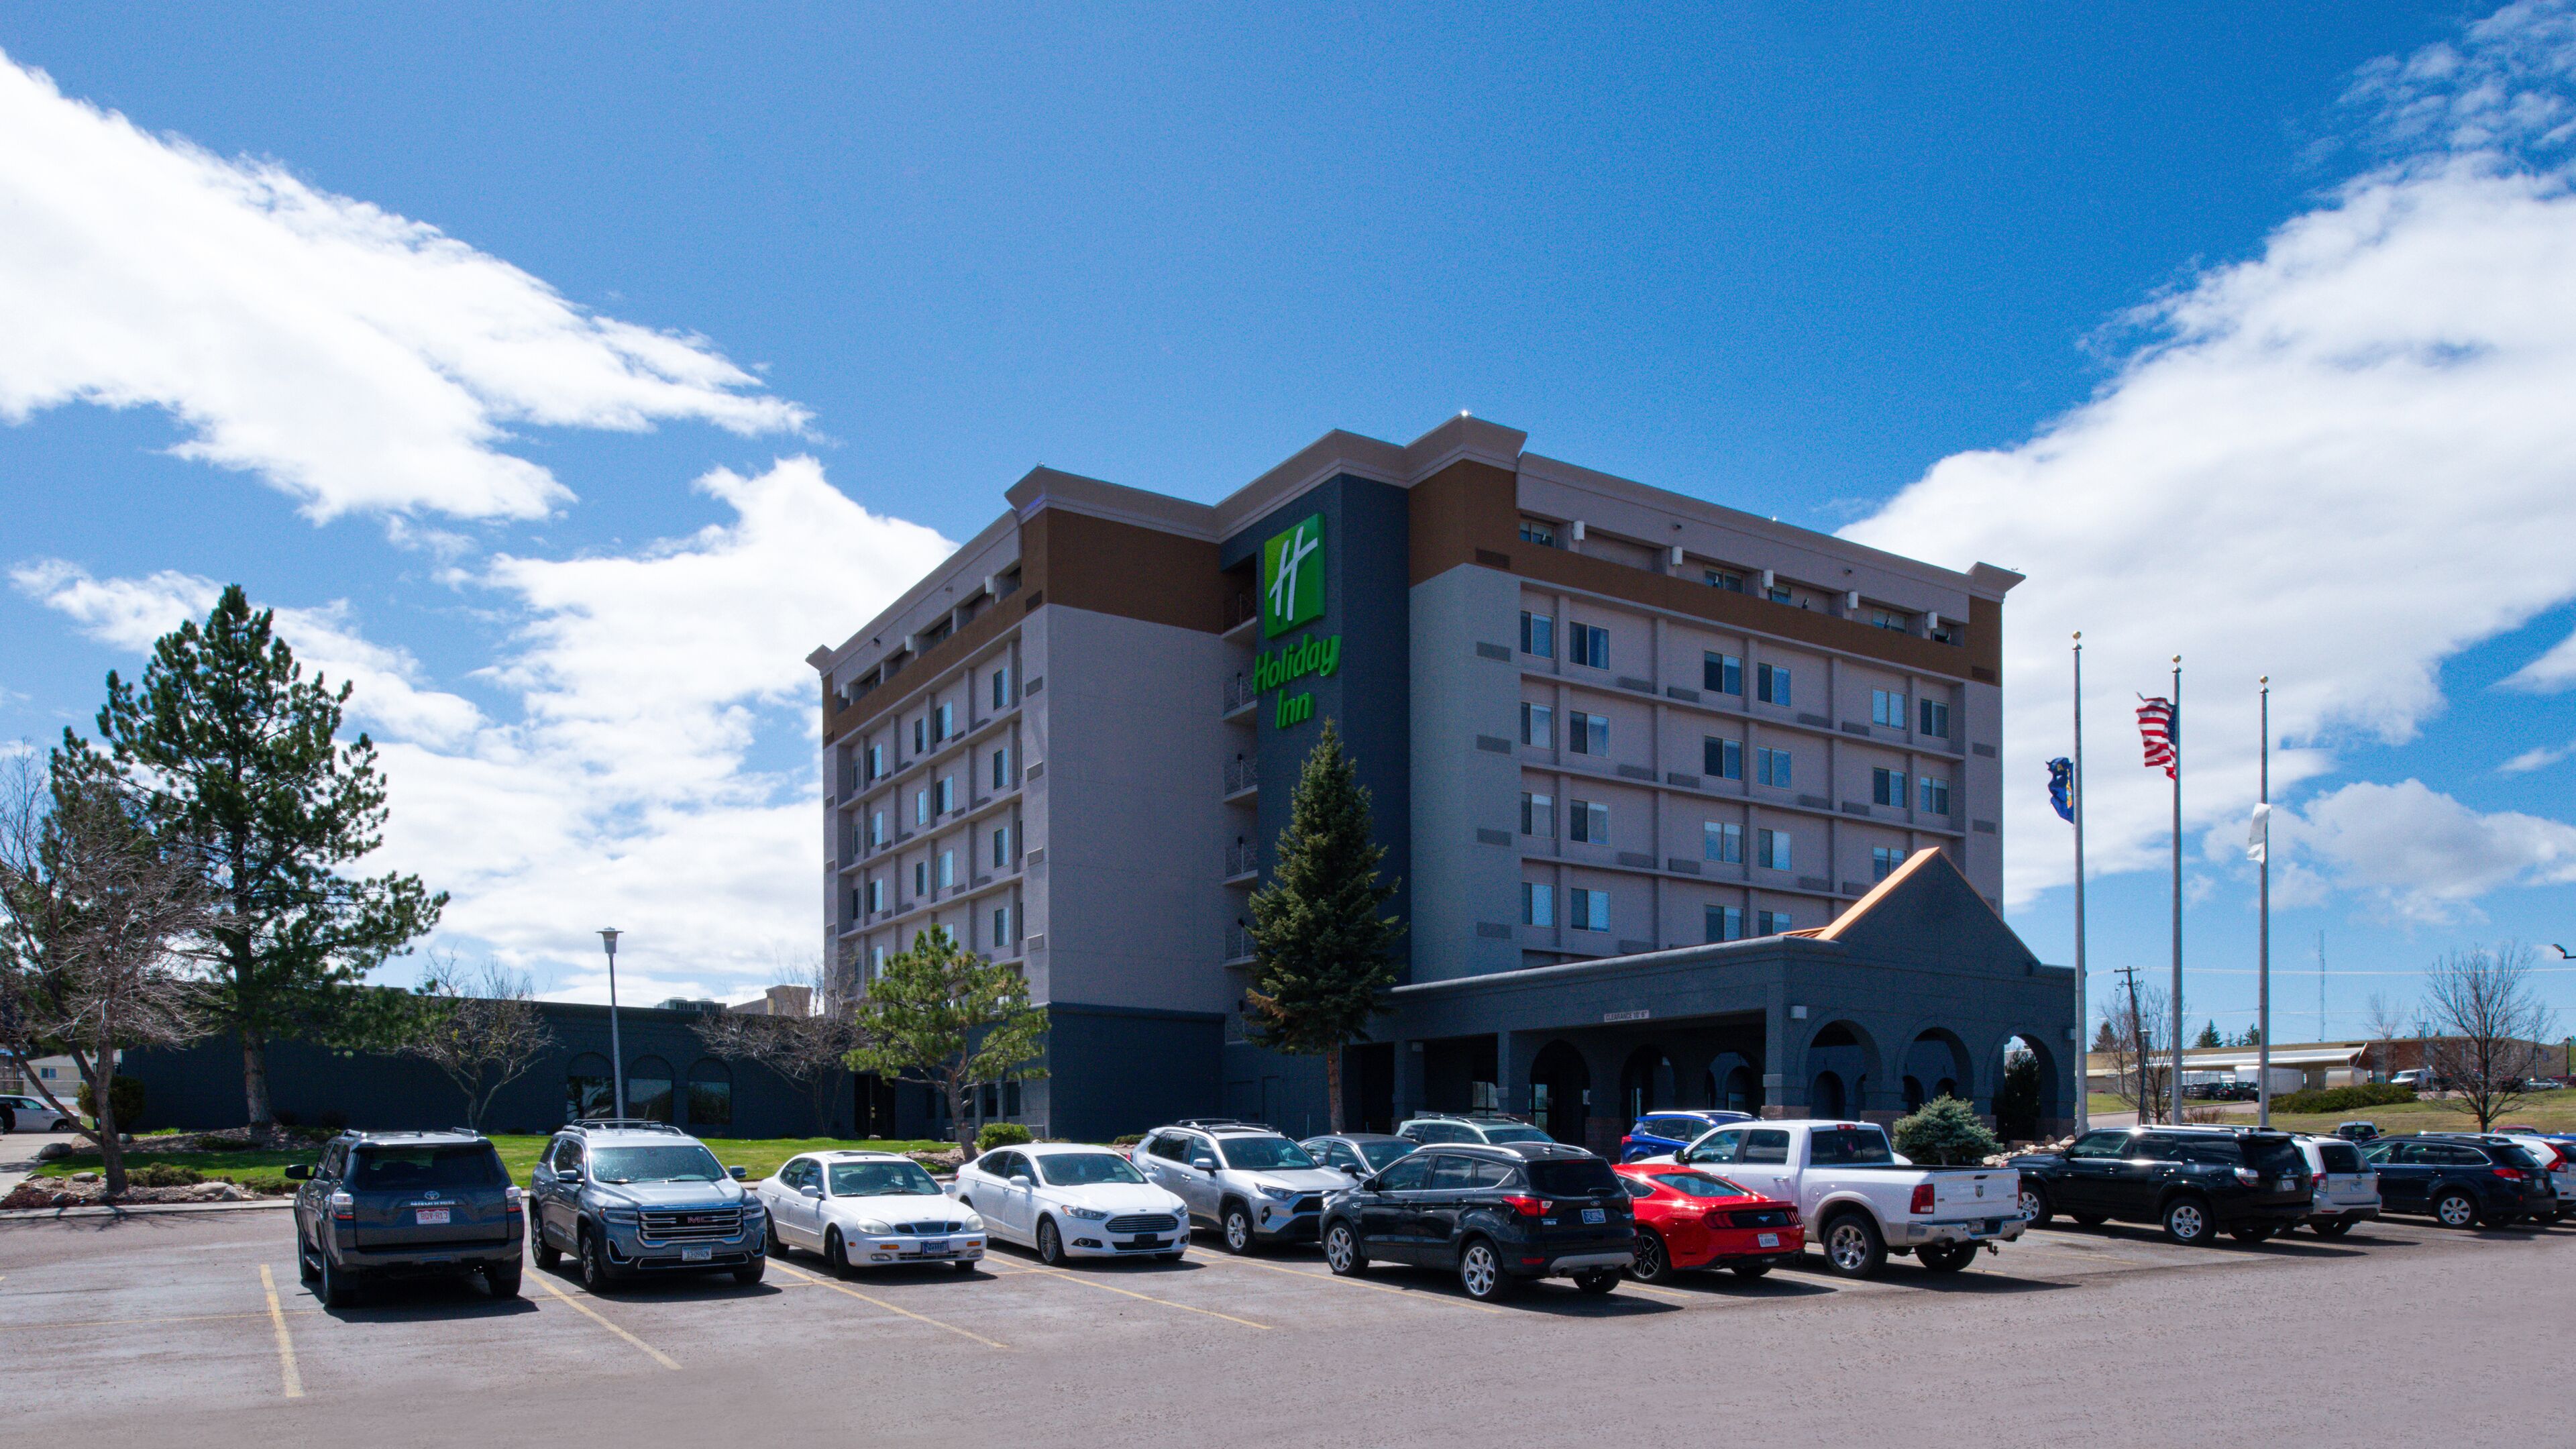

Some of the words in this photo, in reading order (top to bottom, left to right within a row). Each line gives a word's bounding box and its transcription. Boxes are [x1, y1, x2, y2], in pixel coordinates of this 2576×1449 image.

[1253, 633, 1342, 695] Holiday
[1276, 689, 1315, 729] Inn
[1605, 1012, 1632, 1022] CLEARANCE
